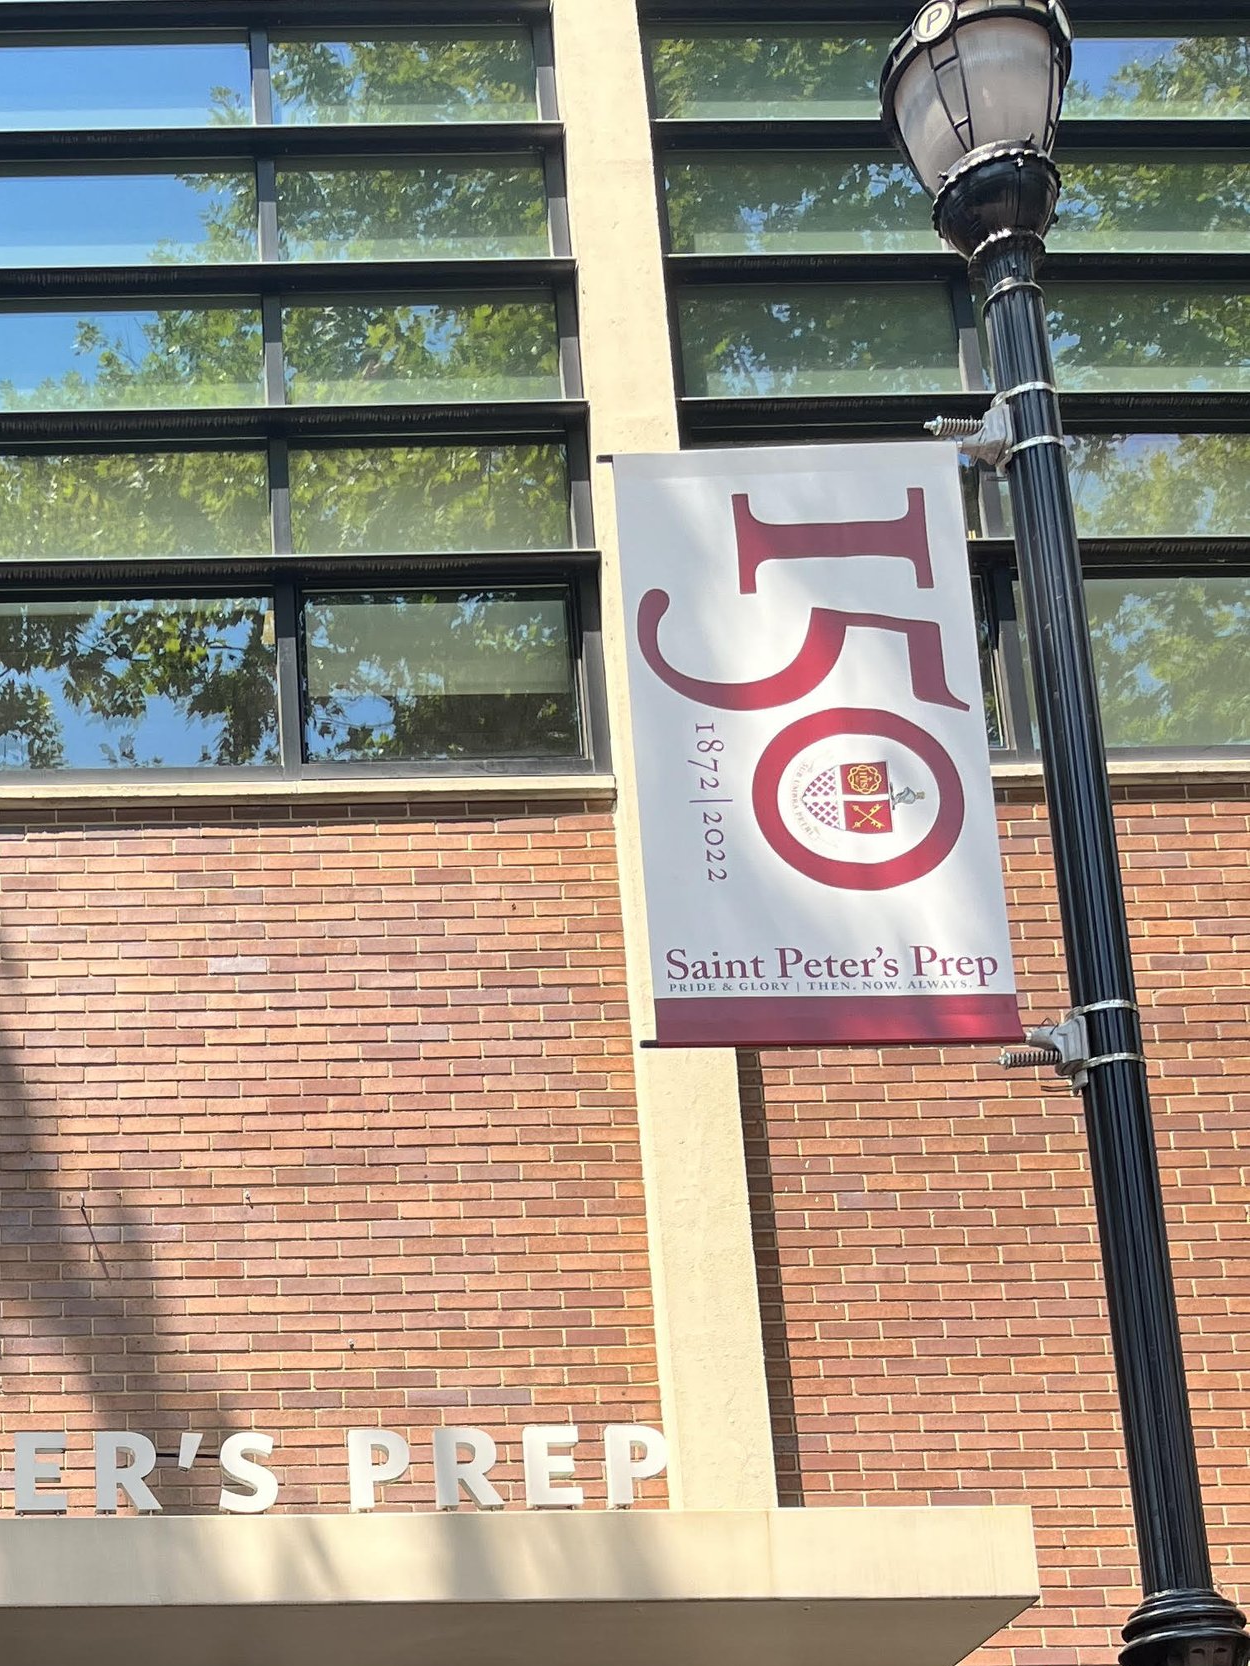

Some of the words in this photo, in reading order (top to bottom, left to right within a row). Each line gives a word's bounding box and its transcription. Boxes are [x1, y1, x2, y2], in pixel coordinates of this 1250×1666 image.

[925, 8, 942, 33] P
[636, 487, 970, 891] 150
[666, 948, 766, 981] Saint
[774, 946, 900, 979] Peter's
[908, 945, 999, 987] Prep
[669, 982, 719, 992] PRIDE
[722, 982, 734, 991] &
[738, 981, 790, 991] GLORY
[807, 981, 857, 991] THEN.
[862, 980, 901, 990] NOW.
[907, 979, 972, 990] ALWAYS.
[347, 1424, 668, 1511] PREP
